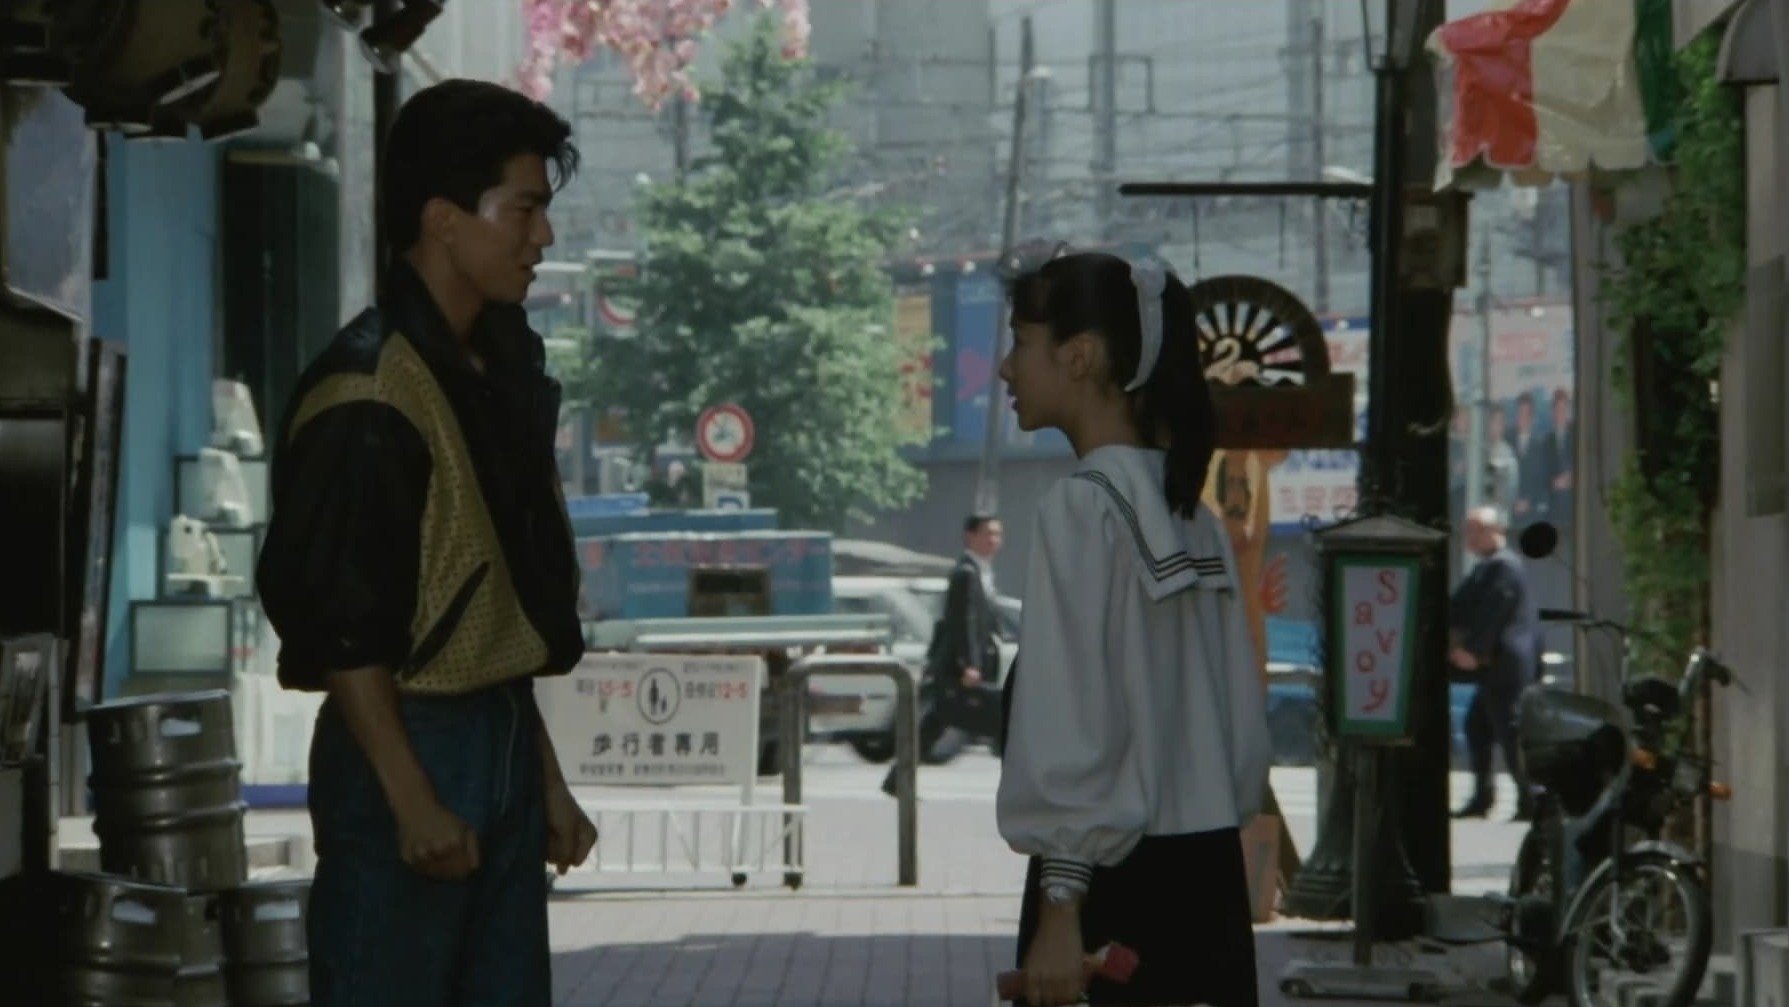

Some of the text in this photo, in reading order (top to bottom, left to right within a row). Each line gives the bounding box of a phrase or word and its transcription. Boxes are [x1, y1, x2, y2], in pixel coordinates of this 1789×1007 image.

[1354, 568, 1399, 714] Savoy
[592, 731, 720, 757] 歩行者専用
